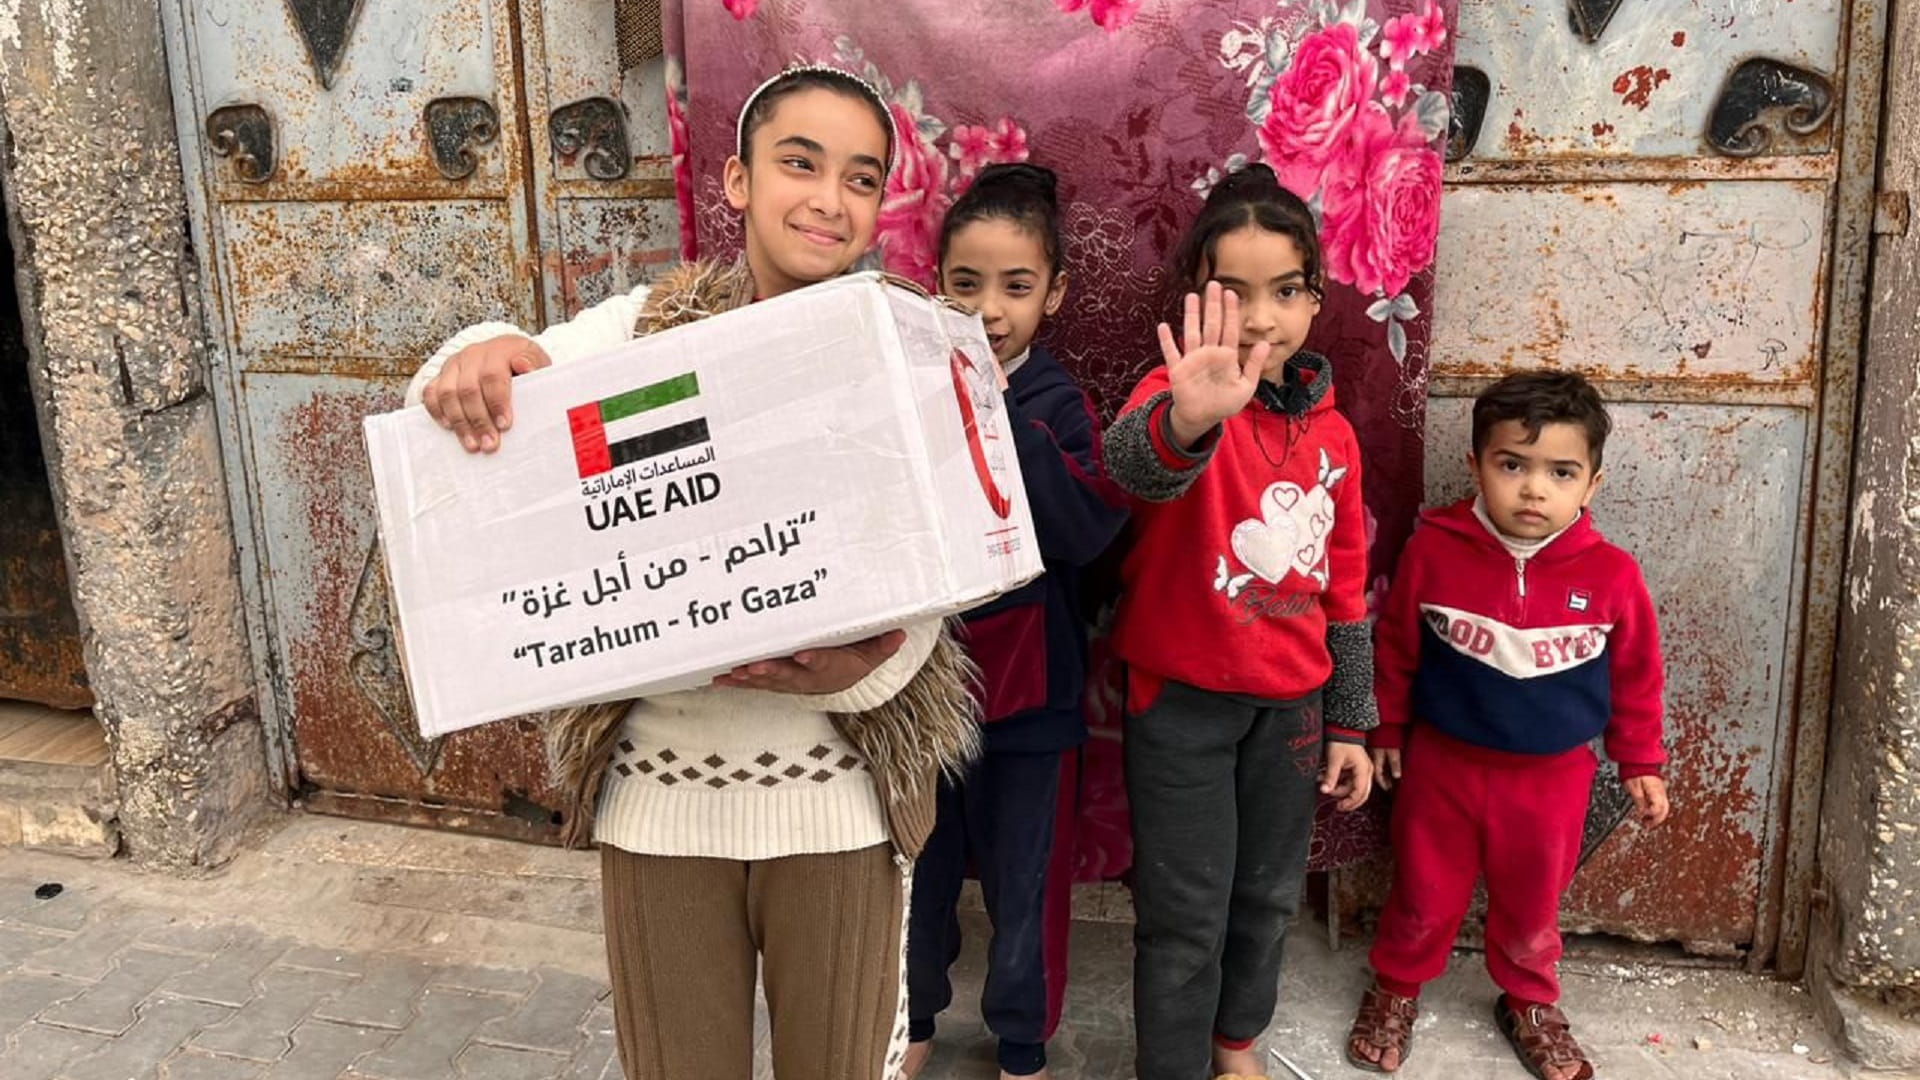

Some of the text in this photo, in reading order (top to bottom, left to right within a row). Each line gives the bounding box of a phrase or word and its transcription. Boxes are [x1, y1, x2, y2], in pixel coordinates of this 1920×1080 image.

[639, 446, 716, 480] المساعدات
[585, 472, 721, 531] UAE AID
[582, 550, 631, 606] أجل
[643, 556, 688, 590] من
[513, 619, 660, 668] “Tarahum
[688, 598, 733, 629] for
[741, 568, 828, 614] Gaza”
